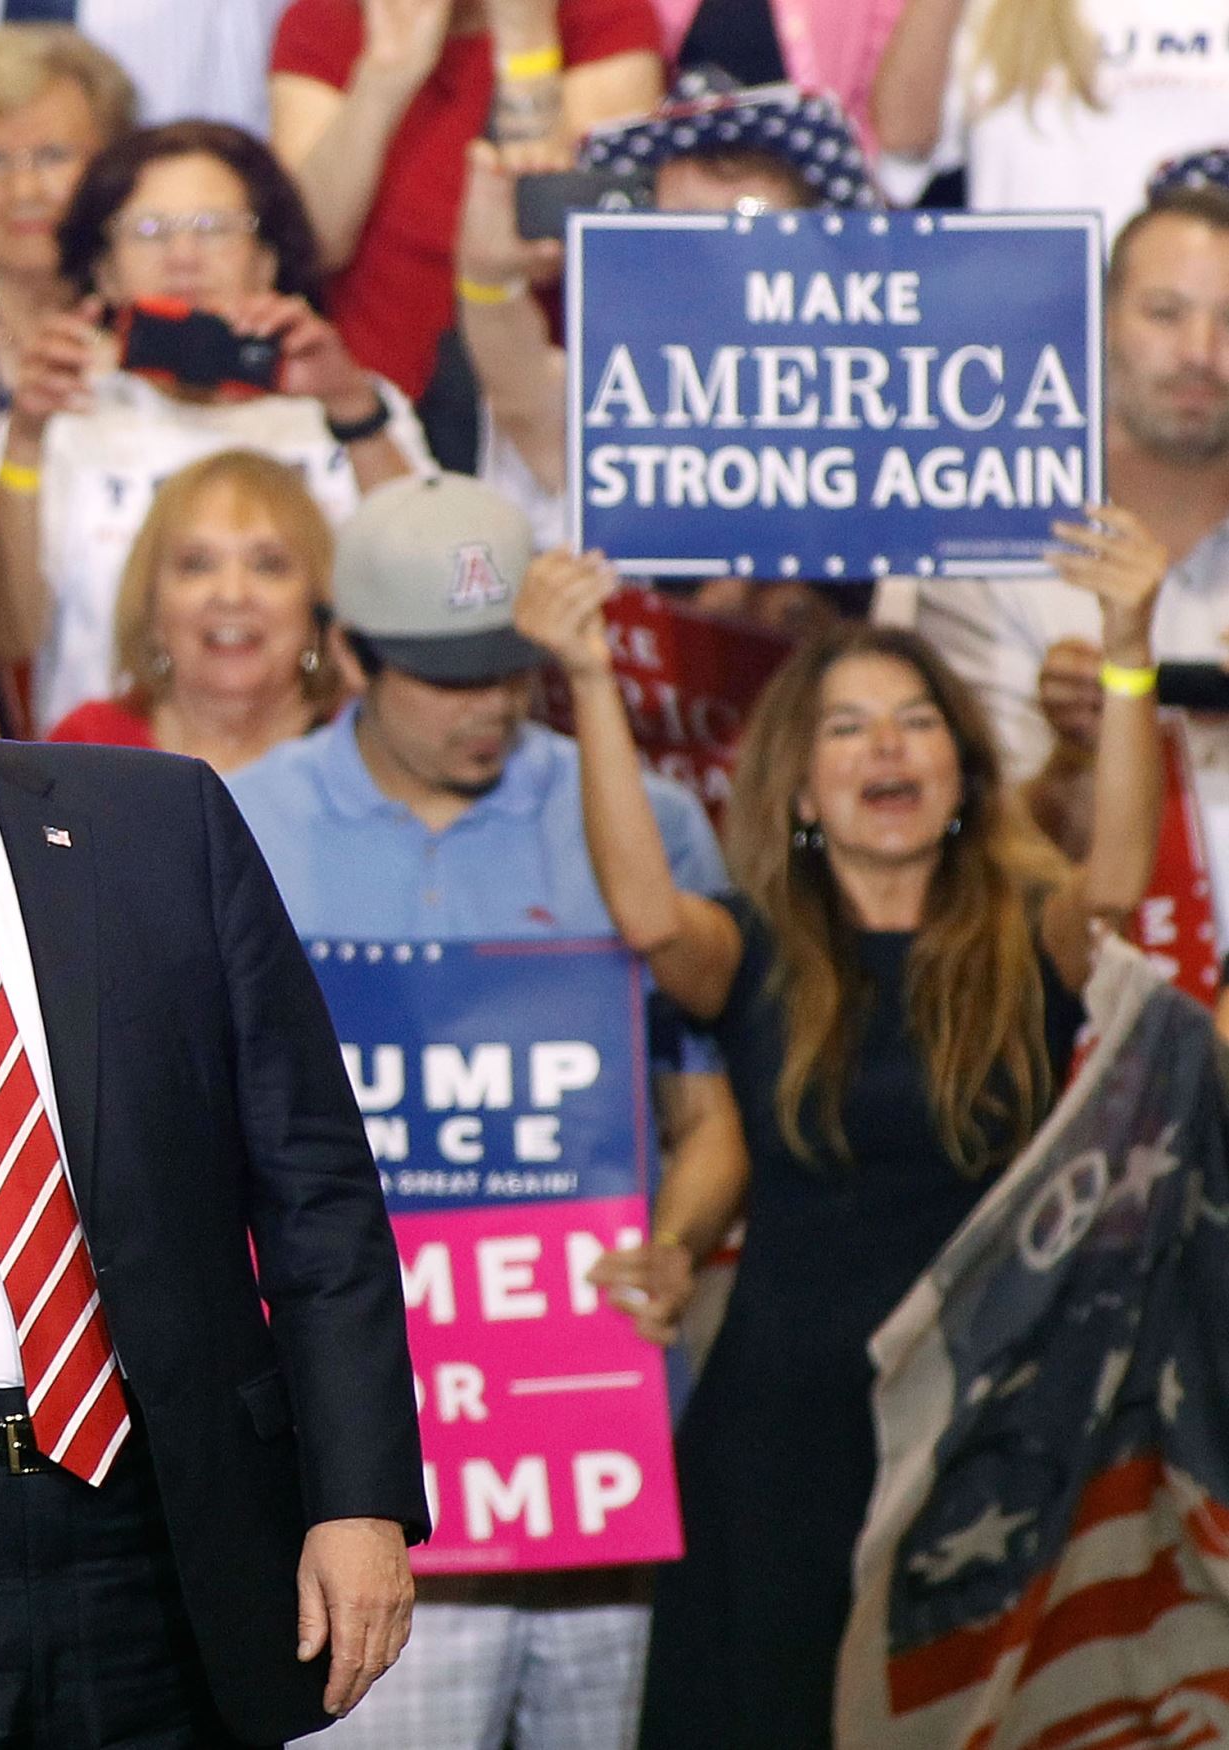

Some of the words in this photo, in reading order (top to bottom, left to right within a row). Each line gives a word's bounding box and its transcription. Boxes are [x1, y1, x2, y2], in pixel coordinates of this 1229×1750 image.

[746, 270, 921, 325] MAKE
[586, 344, 1087, 431] AMERICA
[587, 444, 858, 509] STRONG
[873, 446, 1084, 508] AGAIN
